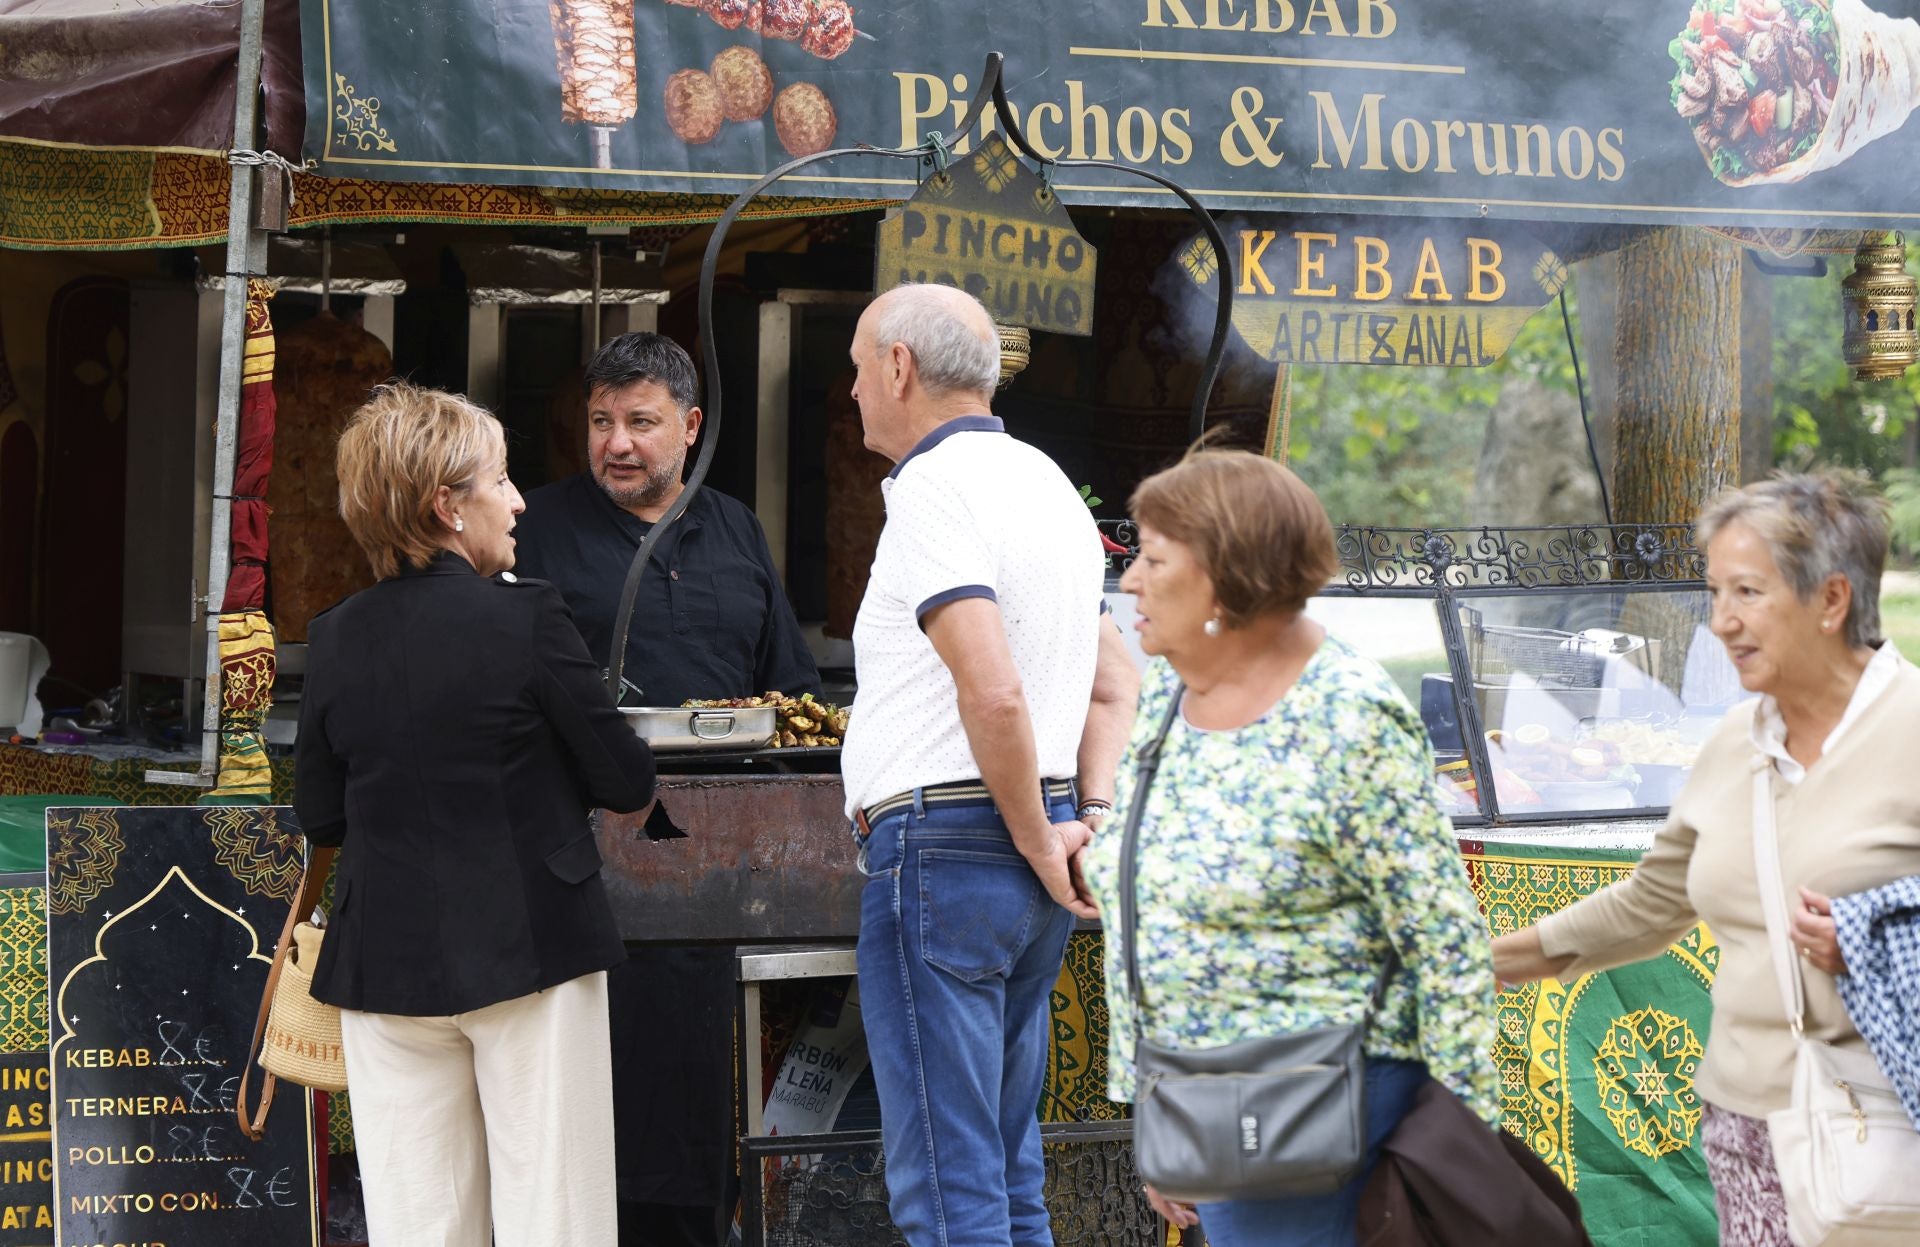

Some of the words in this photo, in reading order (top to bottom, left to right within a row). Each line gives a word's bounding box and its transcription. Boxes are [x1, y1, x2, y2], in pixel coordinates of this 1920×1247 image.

[892, 71, 1193, 165] Pinchos
[1219, 86, 1284, 168] &
[1308, 91, 1626, 182] Morunos
[902, 209, 1084, 273] PINCHO
[1237, 229, 1507, 302] KEBAB
[65, 1048, 150, 1069] KEBAB
[786, 1065, 834, 1096] LEÑA
[65, 1096, 187, 1117] TERNERA
[69, 1145, 155, 1166] POLLO
[71, 1193, 154, 1215] MIXTO
[159, 1192, 218, 1212] CON
